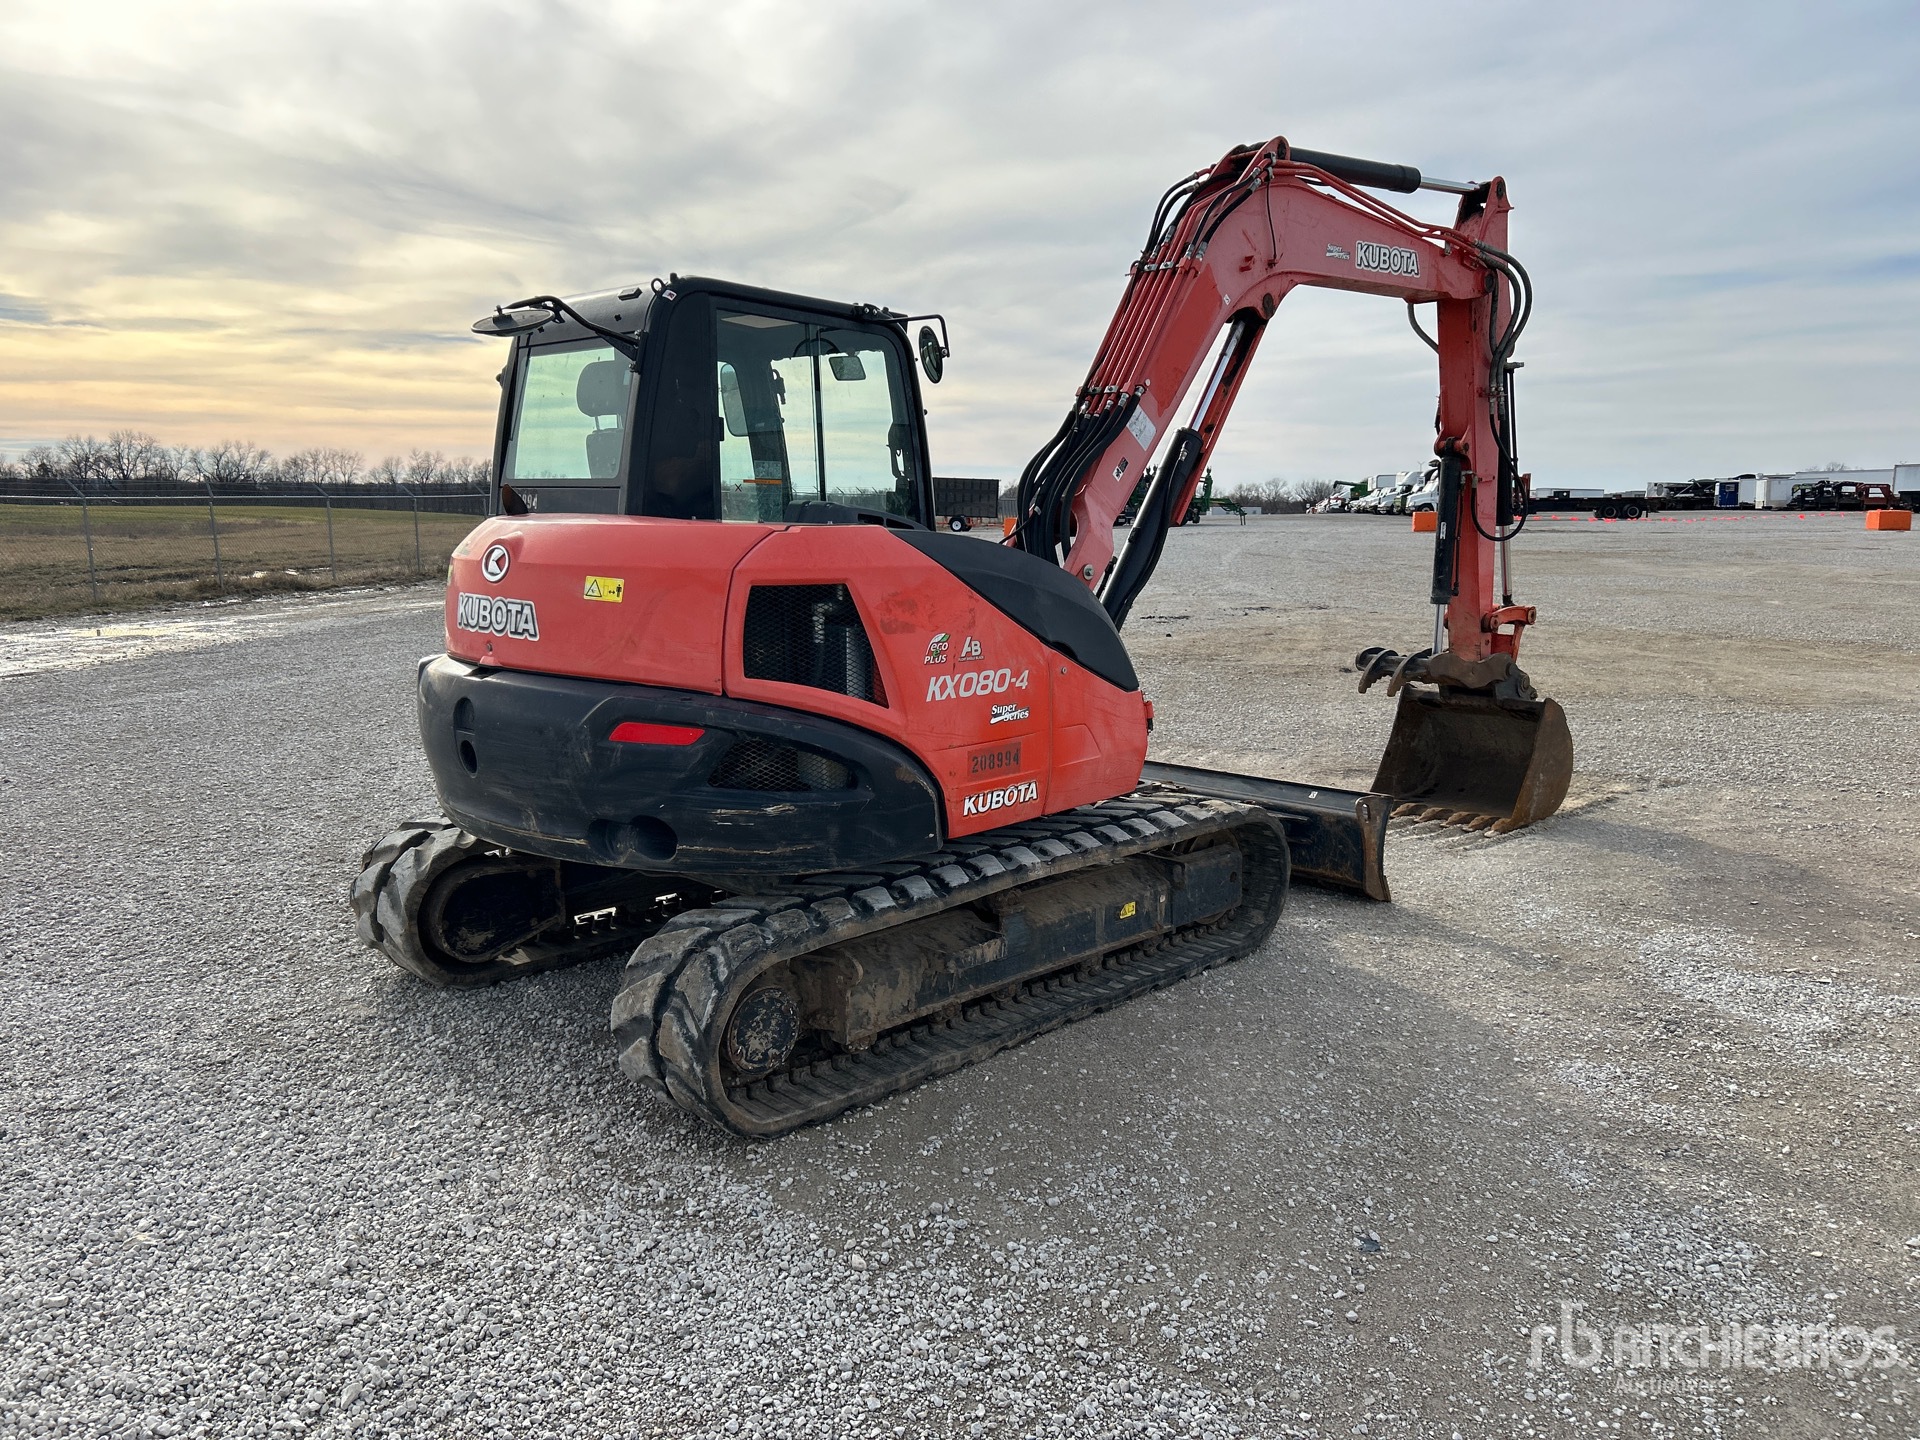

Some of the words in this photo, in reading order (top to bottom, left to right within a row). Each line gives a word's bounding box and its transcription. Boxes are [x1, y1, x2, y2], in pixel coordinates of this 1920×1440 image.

[1357, 242, 1420, 276] KUBOTA
[458, 593, 538, 640] KUBOTA
[930, 642, 949, 651] eco
[924, 654, 947, 665] PLUS
[926, 668, 1030, 702] KX080-4
[991, 703, 1017, 715] Super
[1003, 710, 1030, 722] Series
[972, 750, 1020, 773] 208994
[963, 783, 1038, 815] KUBOTA
